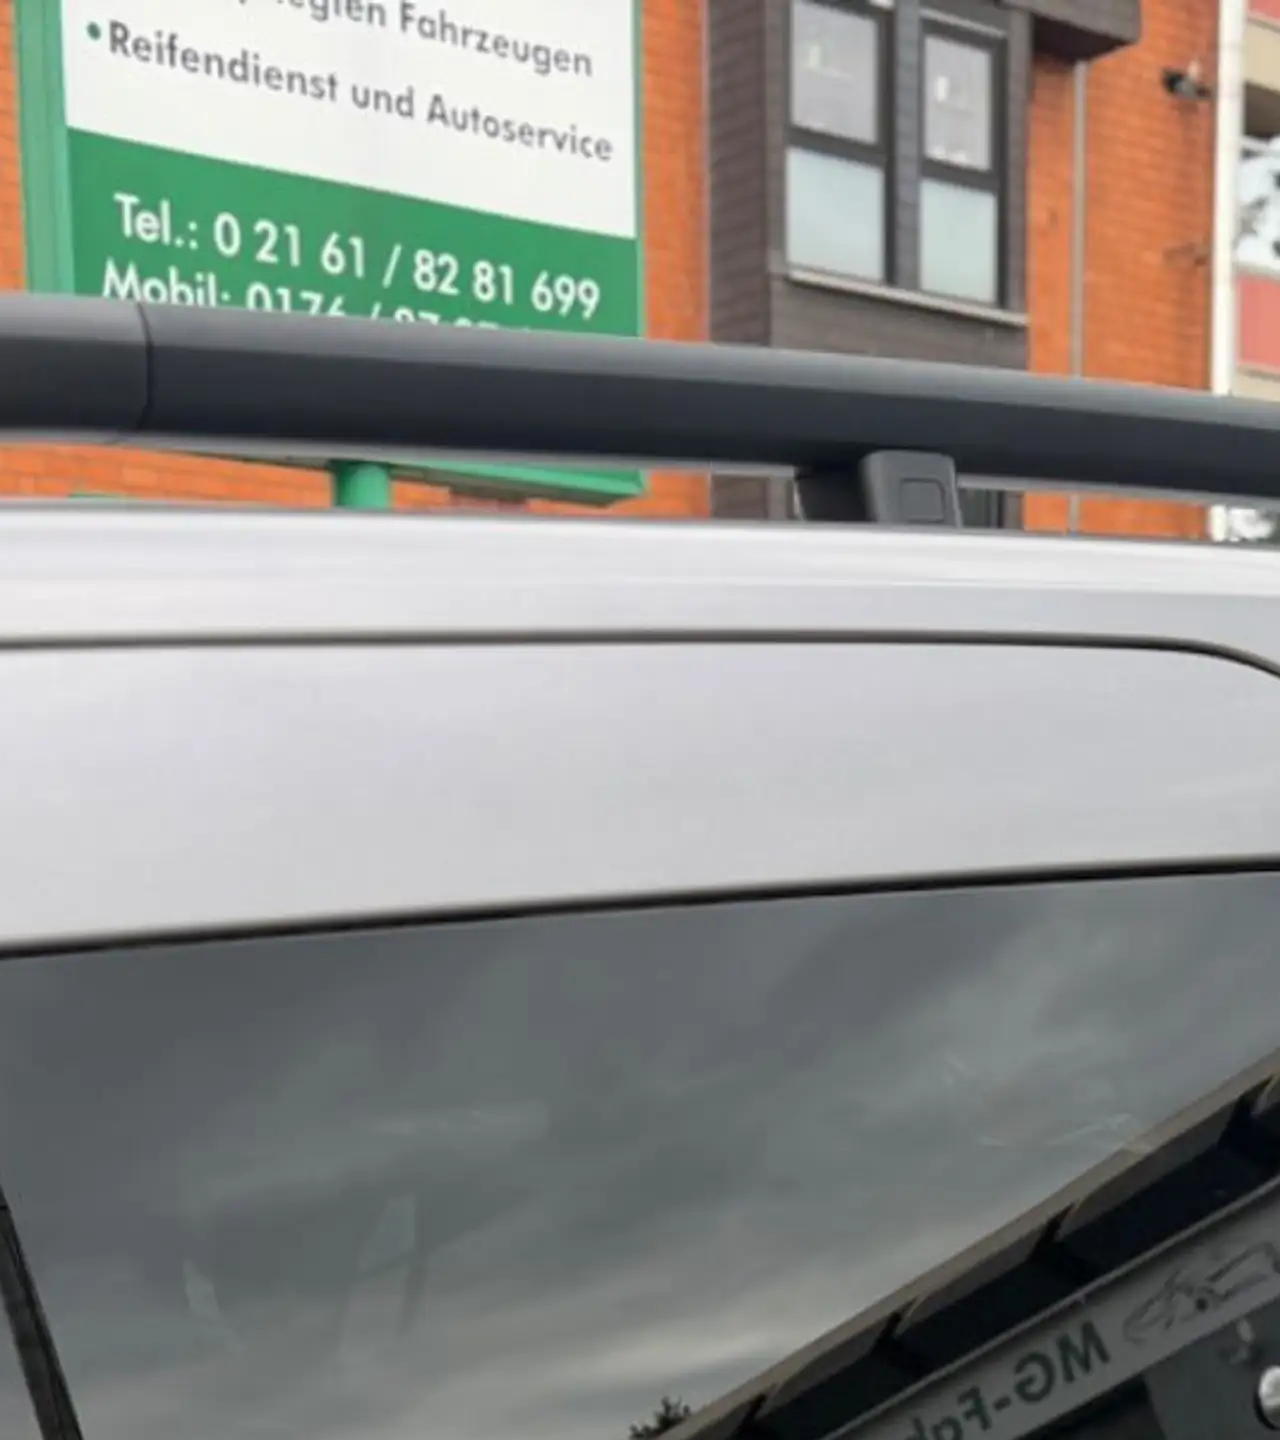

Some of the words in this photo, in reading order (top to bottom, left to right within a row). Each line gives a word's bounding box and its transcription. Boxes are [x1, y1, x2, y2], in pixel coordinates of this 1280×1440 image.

[109, 20, 338, 102] Reifendienst
[351, 85, 415, 118] und
[427, 93, 613, 162] Autoservice
[400, 2, 593, 77] Fahrzeugen
[113, 190, 198, 249] Tel.:
[213, 211, 241, 257] 0
[253, 218, 299, 267] 21
[321, 232, 364, 279] 61
[382, 243, 402, 288] /
[413, 248, 459, 296] 82
[473, 260, 513, 305] 81
[531, 270, 600, 320] 699
